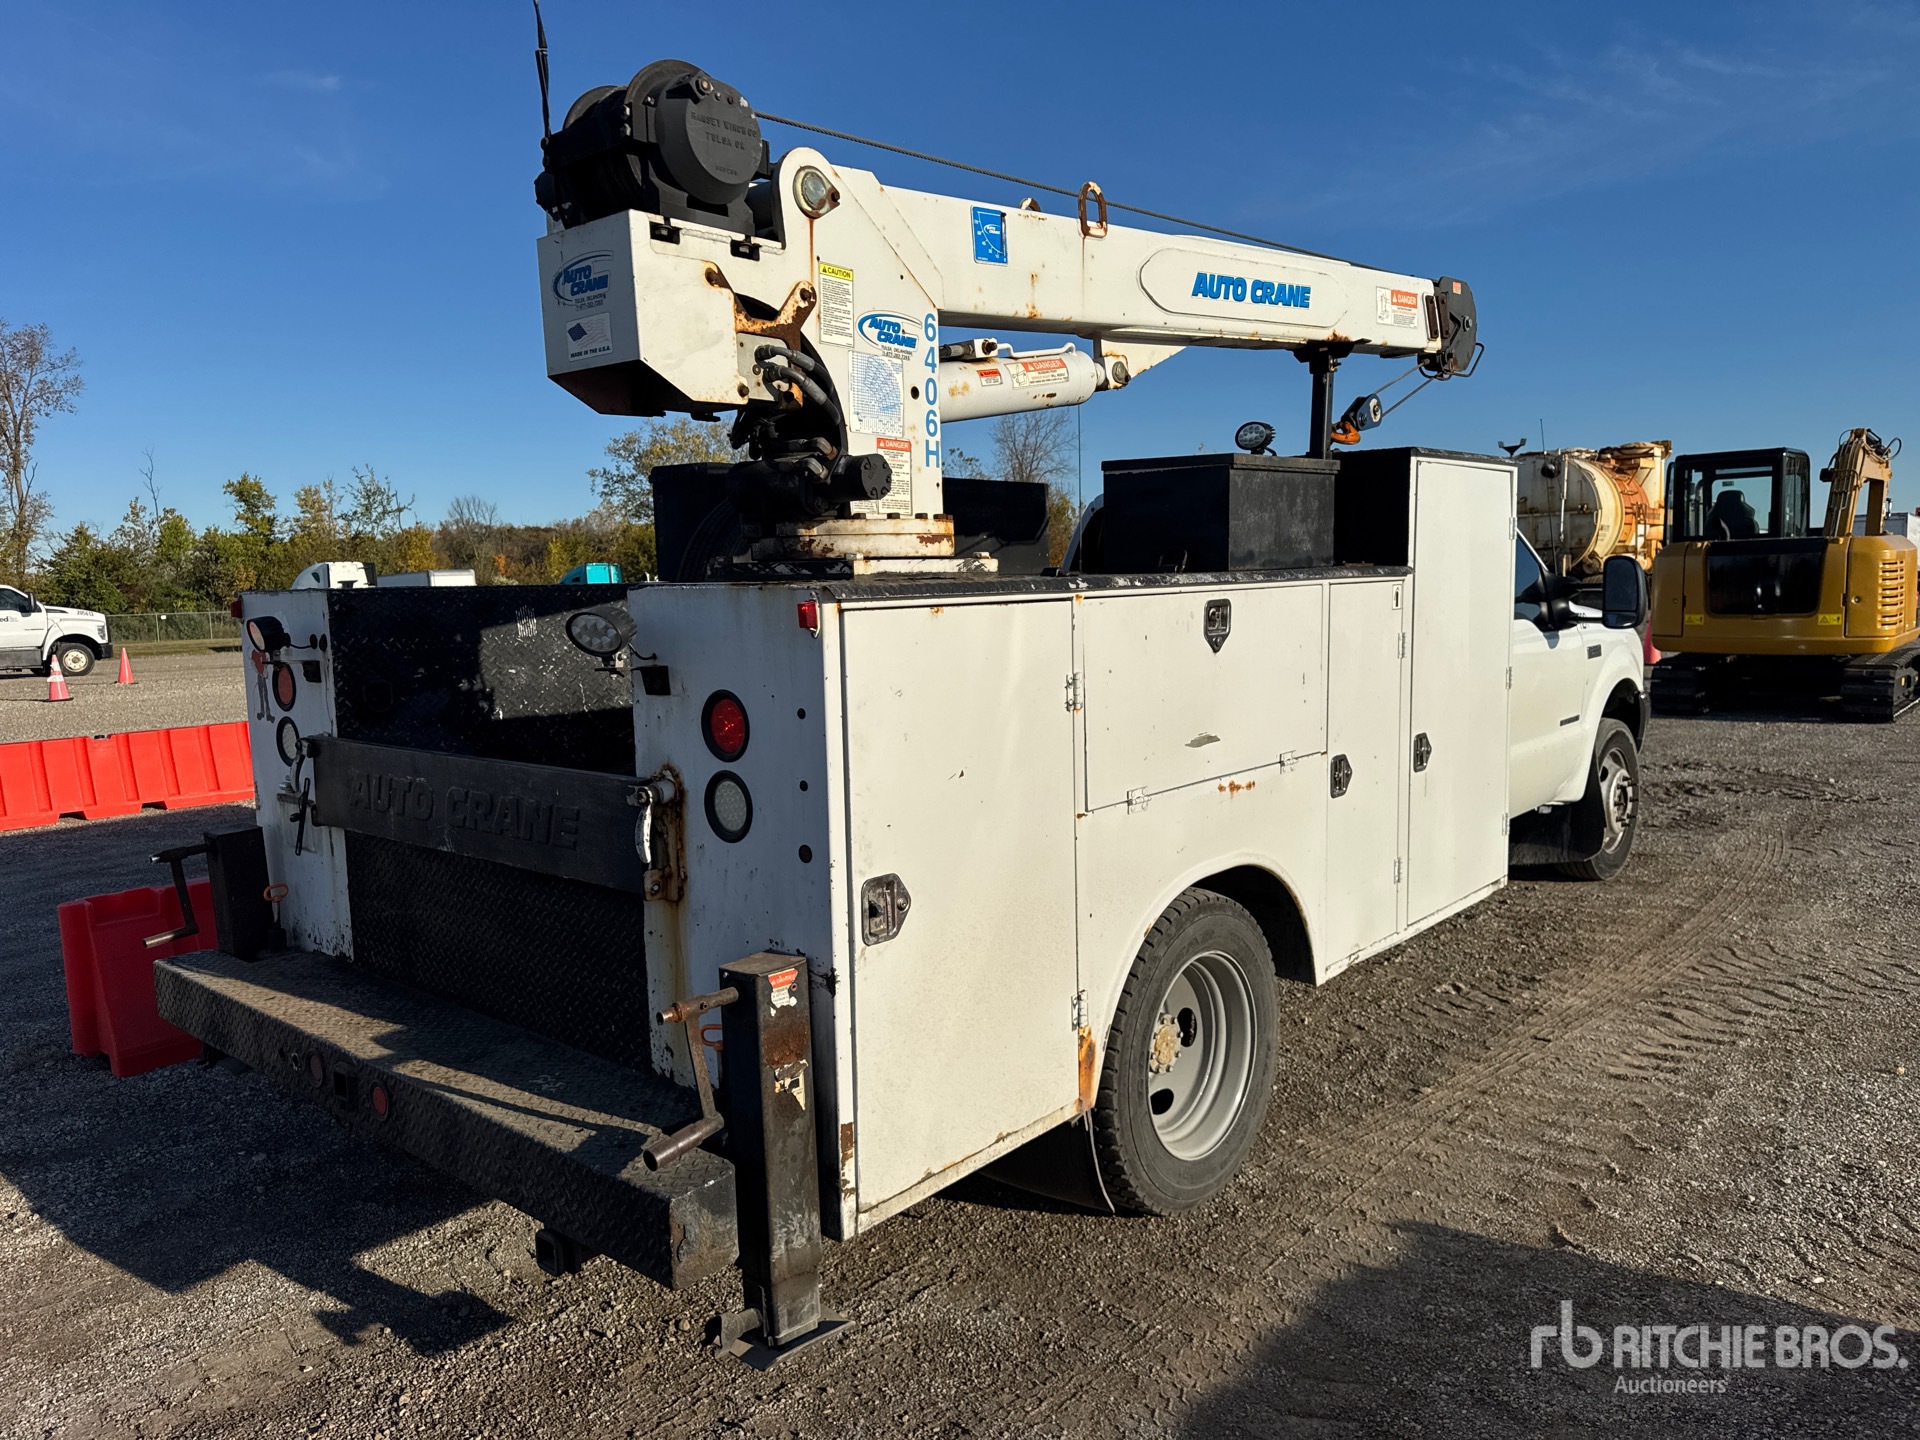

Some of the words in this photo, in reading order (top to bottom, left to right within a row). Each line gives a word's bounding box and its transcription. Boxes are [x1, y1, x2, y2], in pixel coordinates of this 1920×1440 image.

[563, 265, 592, 284] AUTO
[828, 267, 851, 278] CAUTION
[570, 274, 609, 297] CRANE
[1192, 272, 1247, 303] AUTO
[1250, 279, 1311, 309] CRANE
[1397, 294, 1417, 306] DANGER
[868, 317, 901, 333] AUTO
[877, 330, 917, 349] CRANE
[1033, 360, 1062, 370] DANGER
[924, 313, 940, 468] 6406H
[885, 439, 910, 449] DANGER
[350, 771, 434, 821] AUTO
[444, 785, 580, 851] CRANE
